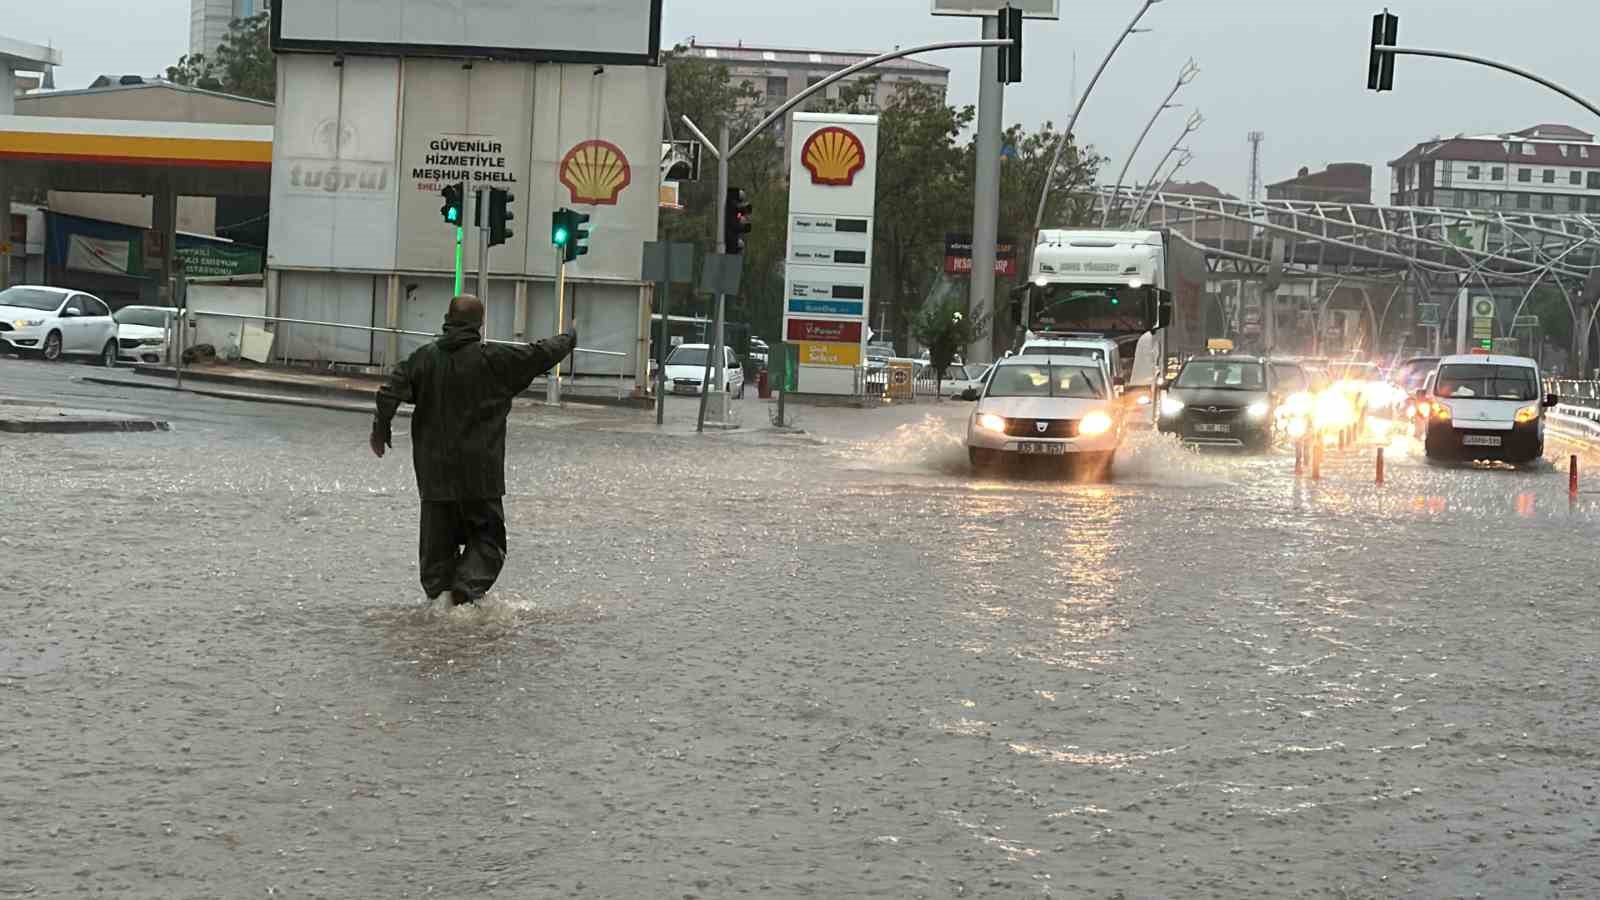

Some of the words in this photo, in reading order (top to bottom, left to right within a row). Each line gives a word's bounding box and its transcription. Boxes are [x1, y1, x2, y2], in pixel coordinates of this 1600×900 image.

[430, 139, 502, 153] GÜVENİLİR
[425, 152, 505, 167] HİZMETİYLE
[412, 168, 470, 182] MEŞHUR
[473, 171, 516, 182] SHELL
